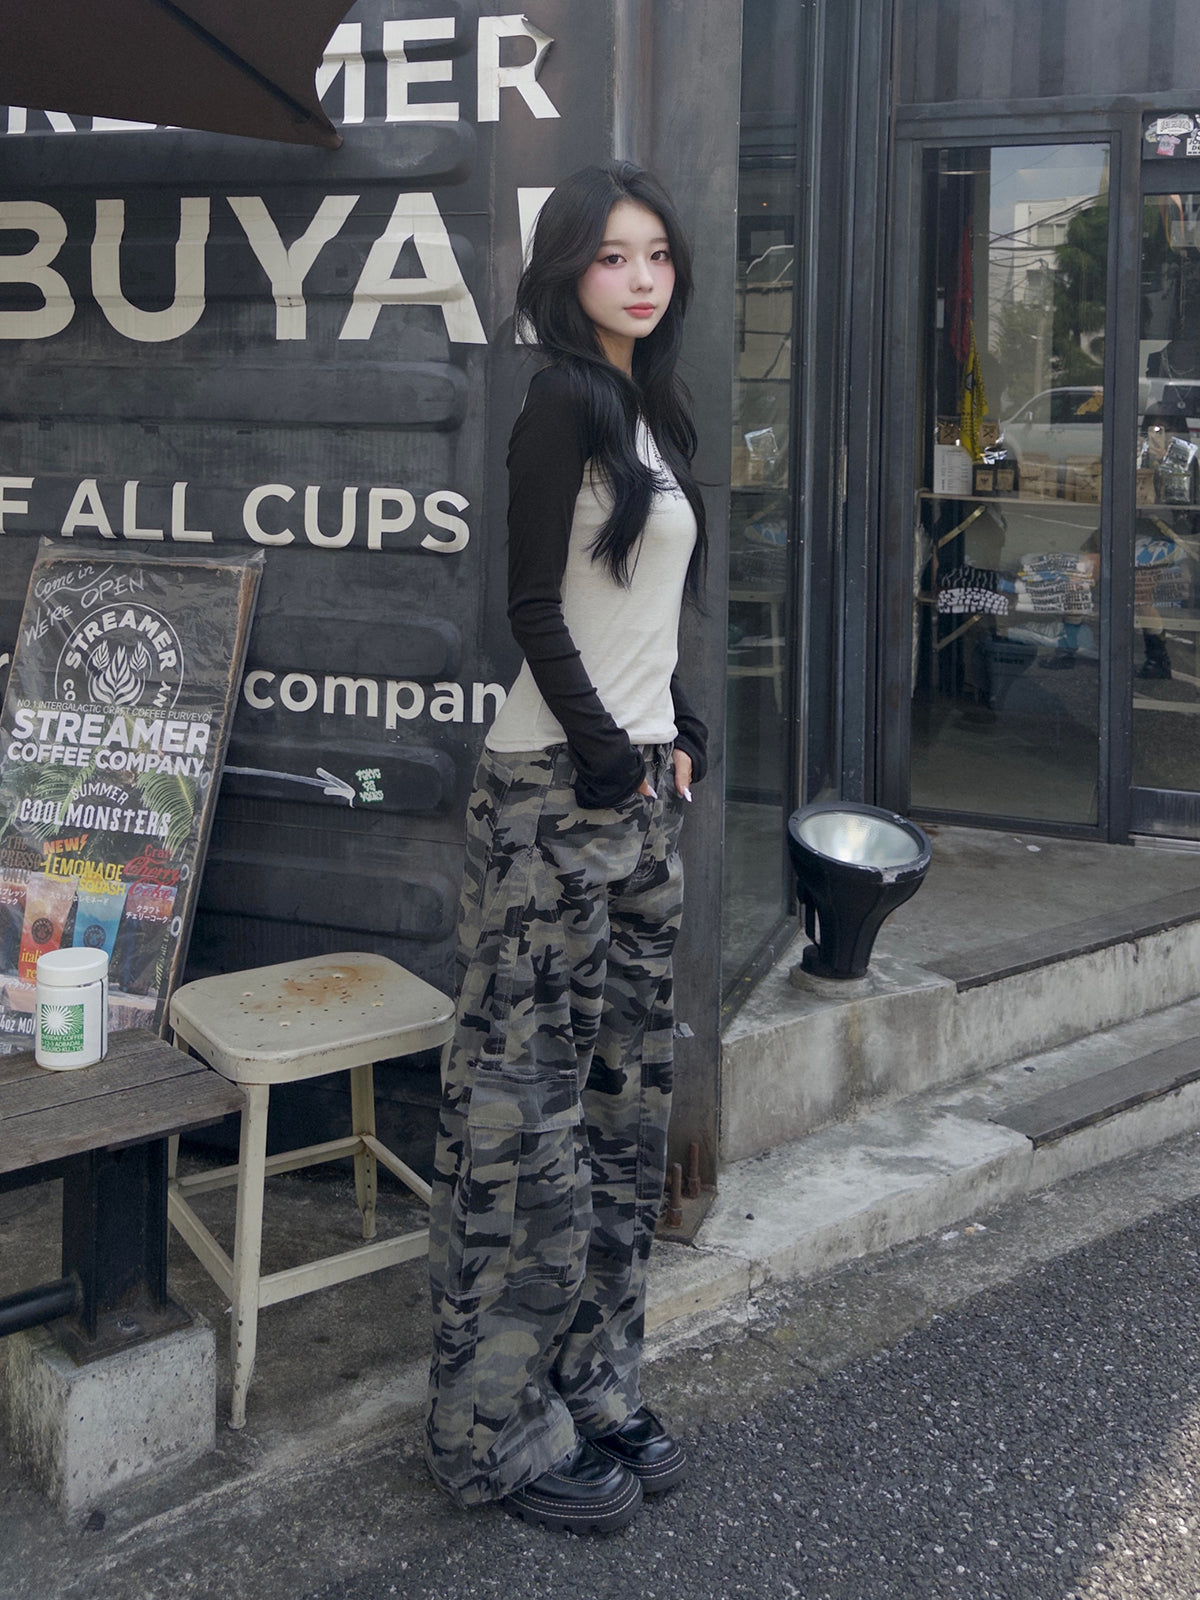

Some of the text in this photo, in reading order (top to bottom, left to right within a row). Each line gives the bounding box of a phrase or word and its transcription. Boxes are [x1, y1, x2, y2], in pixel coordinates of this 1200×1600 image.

[0, 191, 489, 343] BUYA
[61, 479, 214, 543] ALL
[242, 483, 471, 553] CUPS
[77, 563, 95, 580] in
[81, 568, 145, 609] OPEN
[65, 609, 177, 672] STREAMER
[38, 701, 101, 714] INTERGALACTIC
[103, 705, 131, 716] CRAFT
[132, 707, 166, 719] COFFEE
[11, 708, 210, 754] STREAMER
[7, 742, 206, 778] COFFEE COMPANY
[71, 782, 129, 806] SUMMER
[43, 833, 89, 855] NEW!
[40, 854, 125, 882] LEMONADE
[123, 856, 181, 886] Cherry
[78, 878, 126, 896] SQUASH
